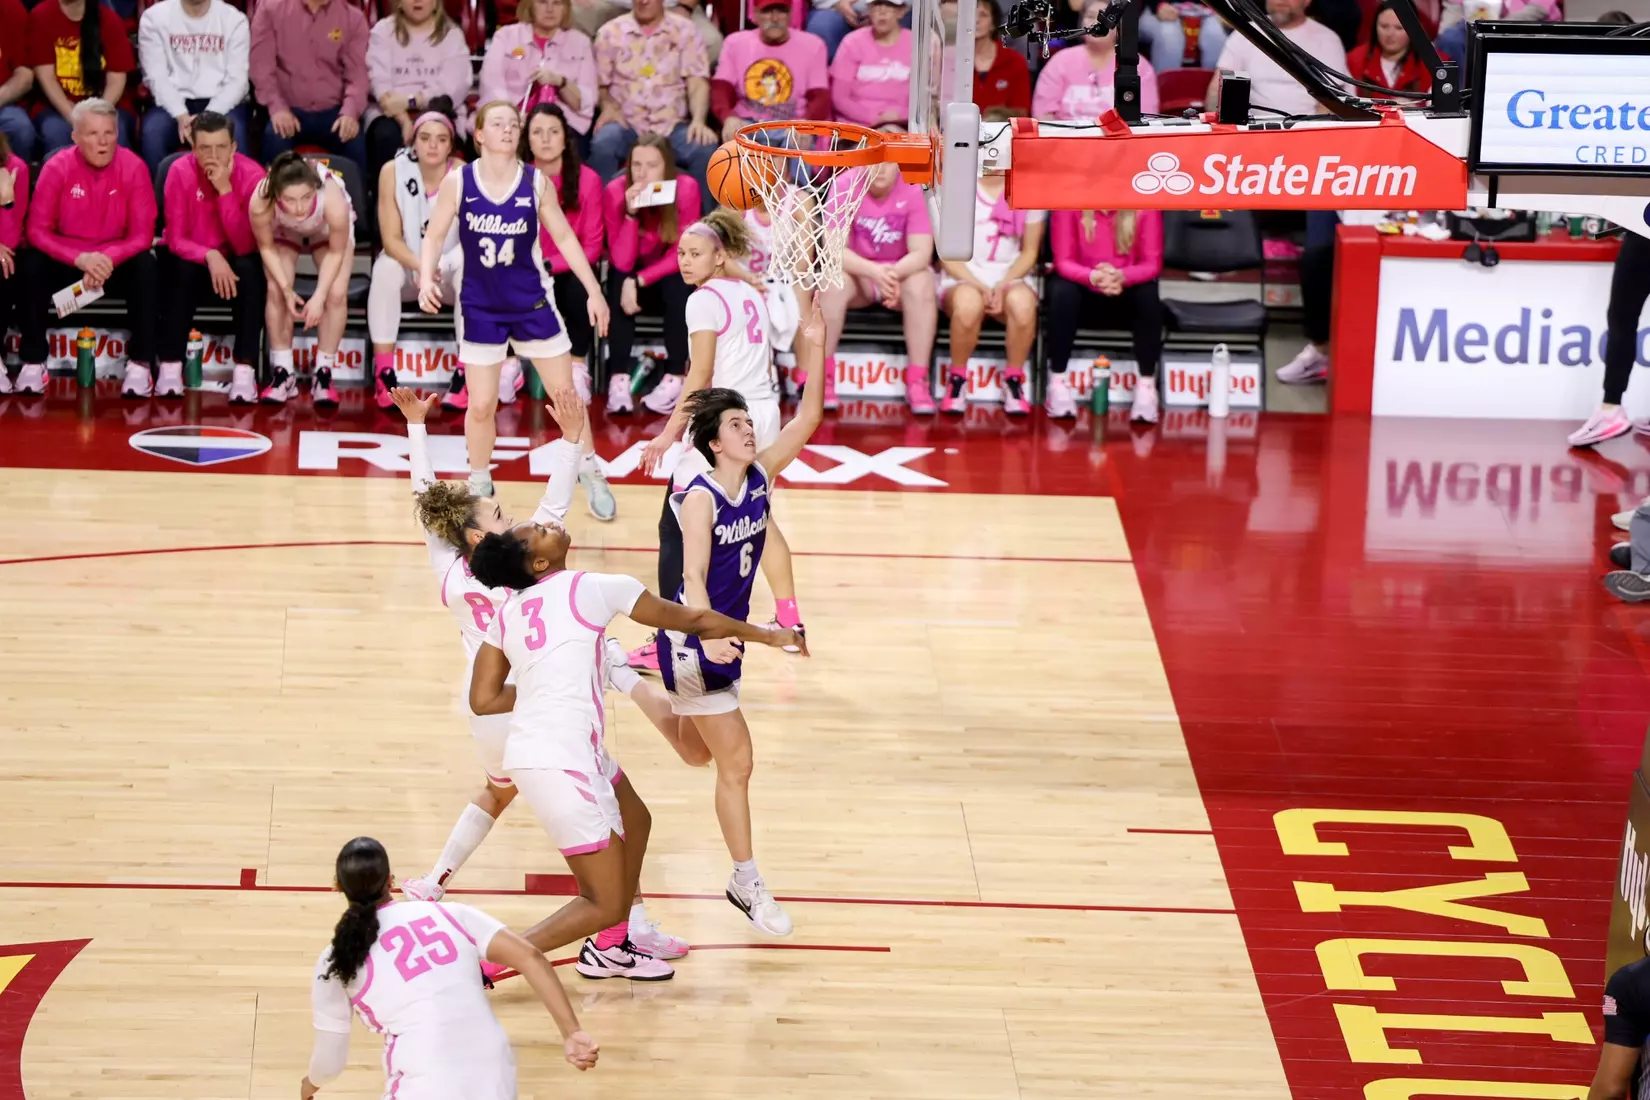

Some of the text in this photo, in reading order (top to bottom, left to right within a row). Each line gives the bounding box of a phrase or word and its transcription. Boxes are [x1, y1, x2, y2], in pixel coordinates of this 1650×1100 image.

[1199, 153, 1417, 196] State Farm
[1575, 145, 1647, 163] CRED
[466, 211, 528, 235] Wildcats
[479, 237, 515, 268] 34
[743, 299, 763, 344] 2
[739, 541, 754, 578] 6
[464, 592, 495, 633] 8
[521, 596, 546, 651] 3
[380, 915, 458, 982] 25
